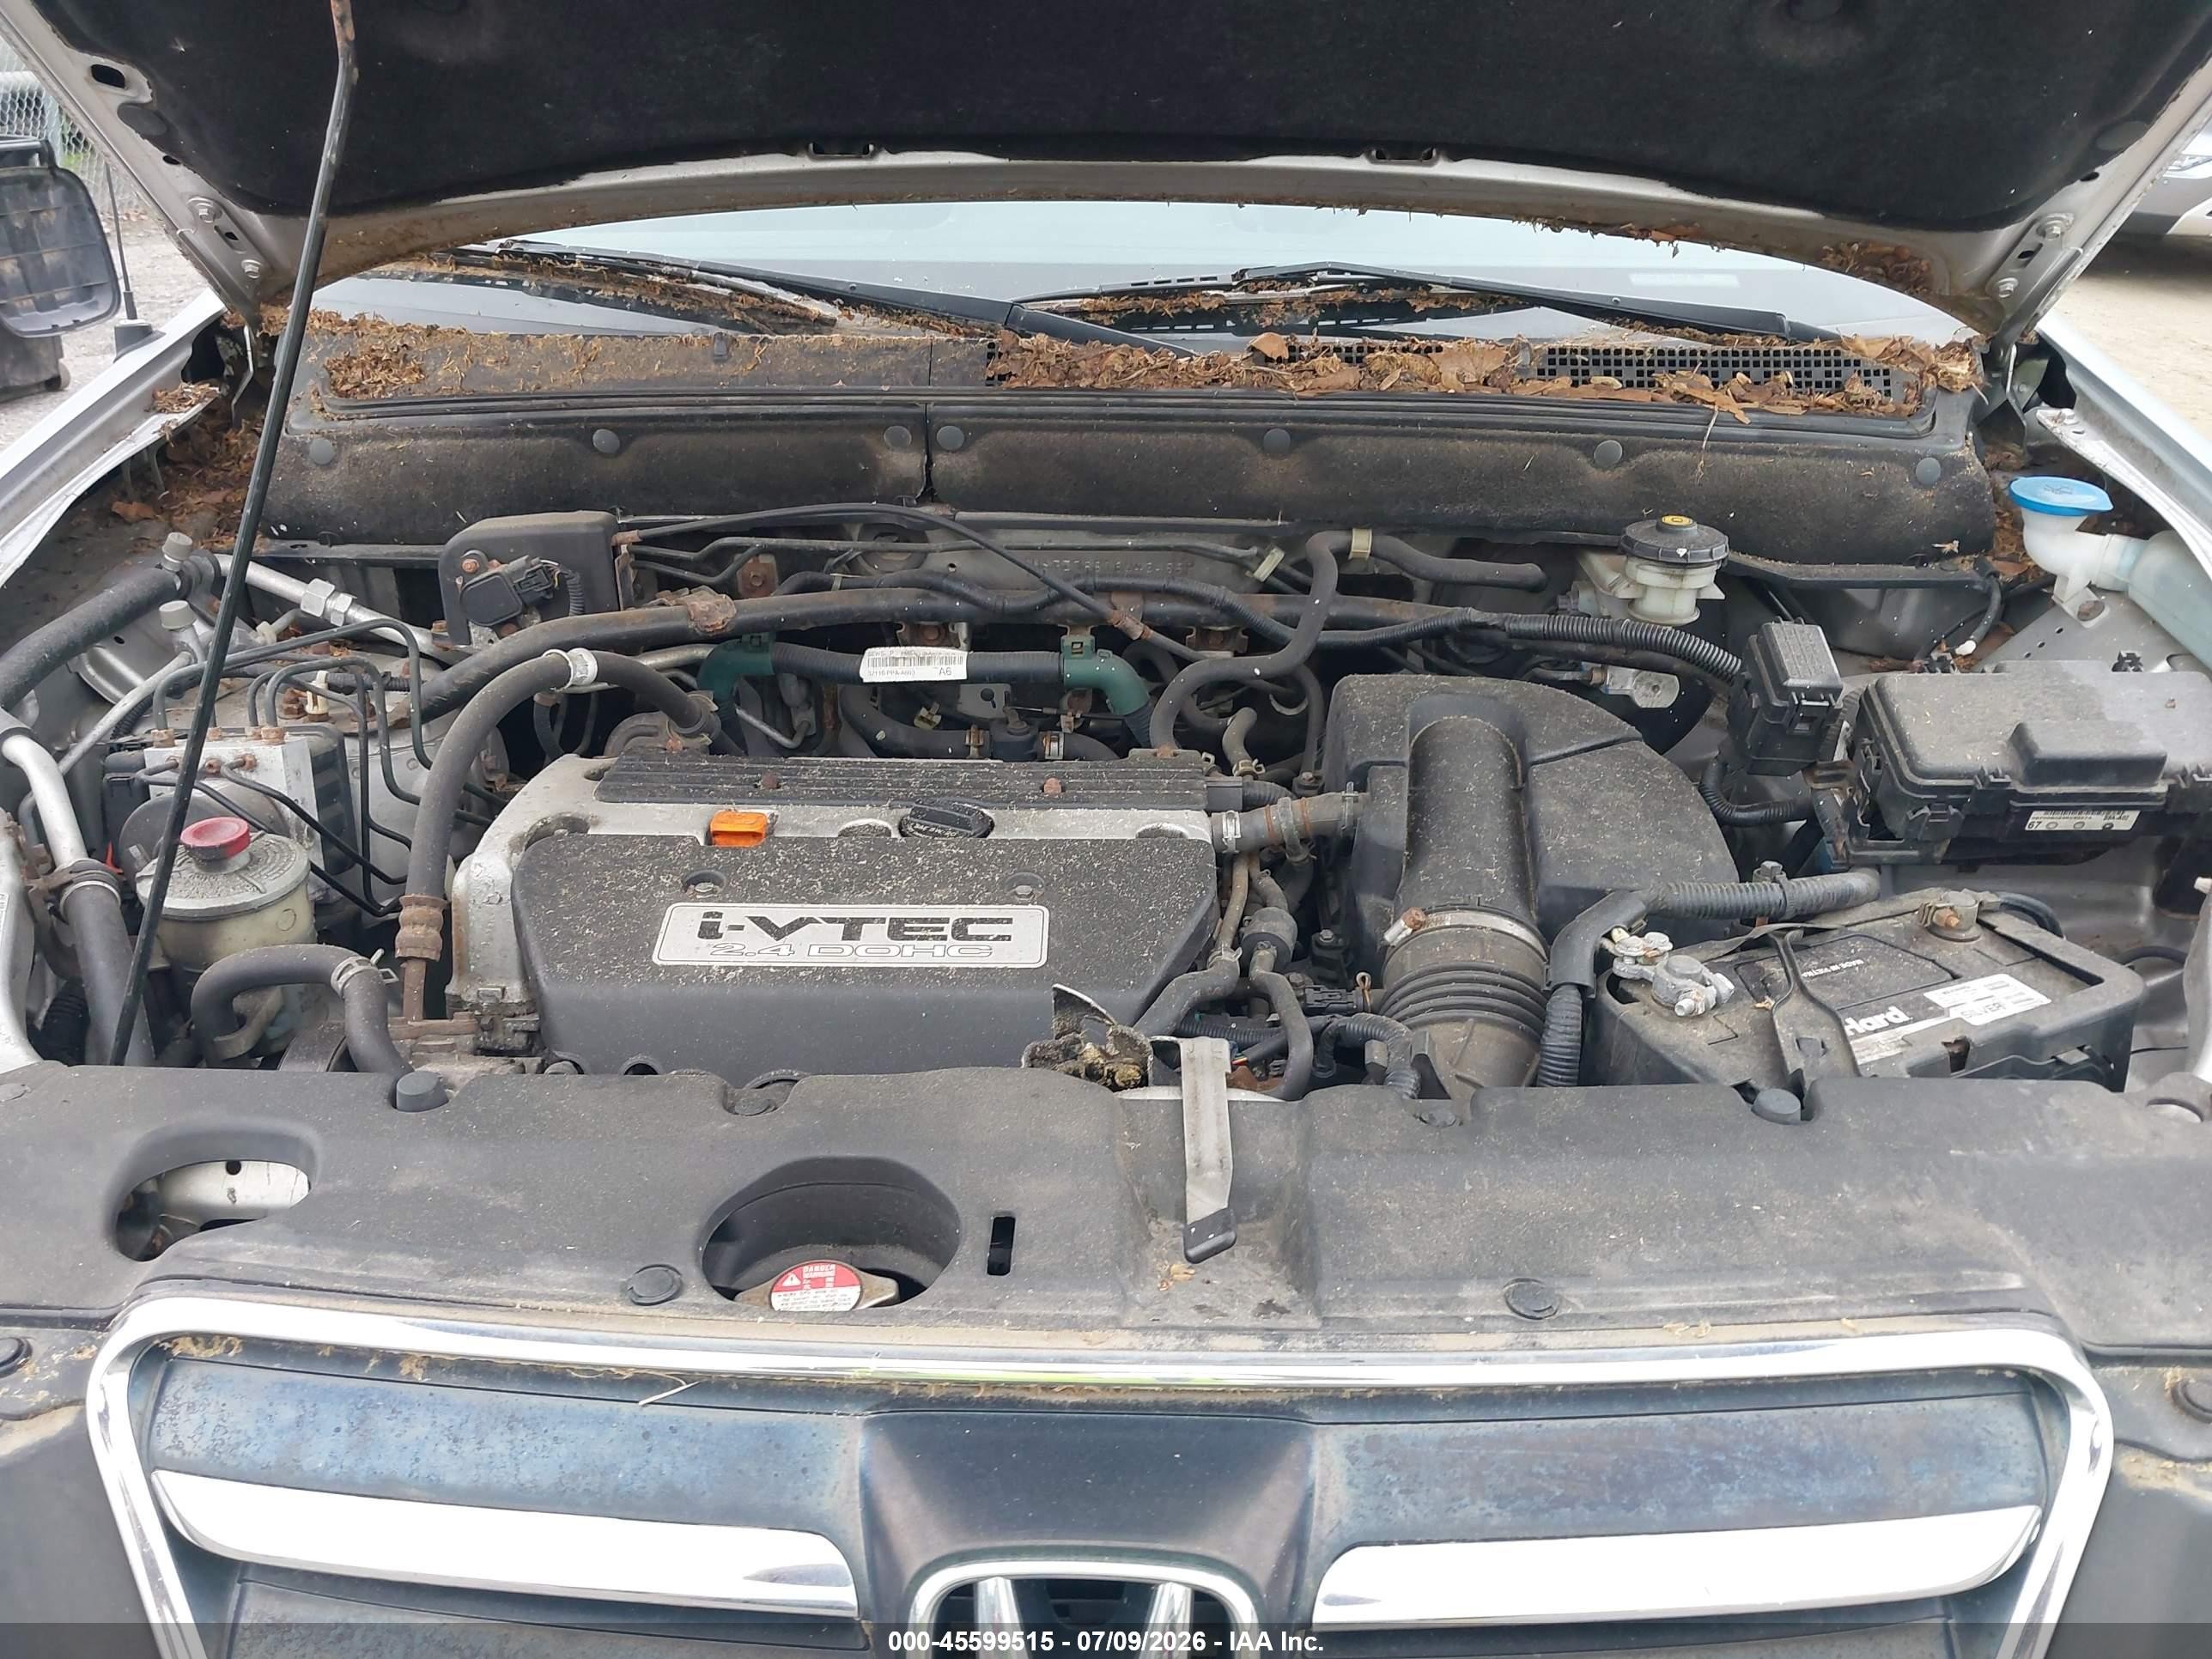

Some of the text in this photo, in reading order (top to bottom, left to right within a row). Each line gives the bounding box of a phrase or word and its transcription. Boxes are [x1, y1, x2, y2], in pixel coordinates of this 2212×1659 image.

[939, 667, 952, 676] A6
[2027, 821, 2043, 830] 67
[696, 911, 1013, 942] i-VTEC
[709, 943, 993, 958] 2.4 DOHC
[1960, 1002, 2007, 1019] SILVER
[804, 1264, 836, 1273] DANGER
